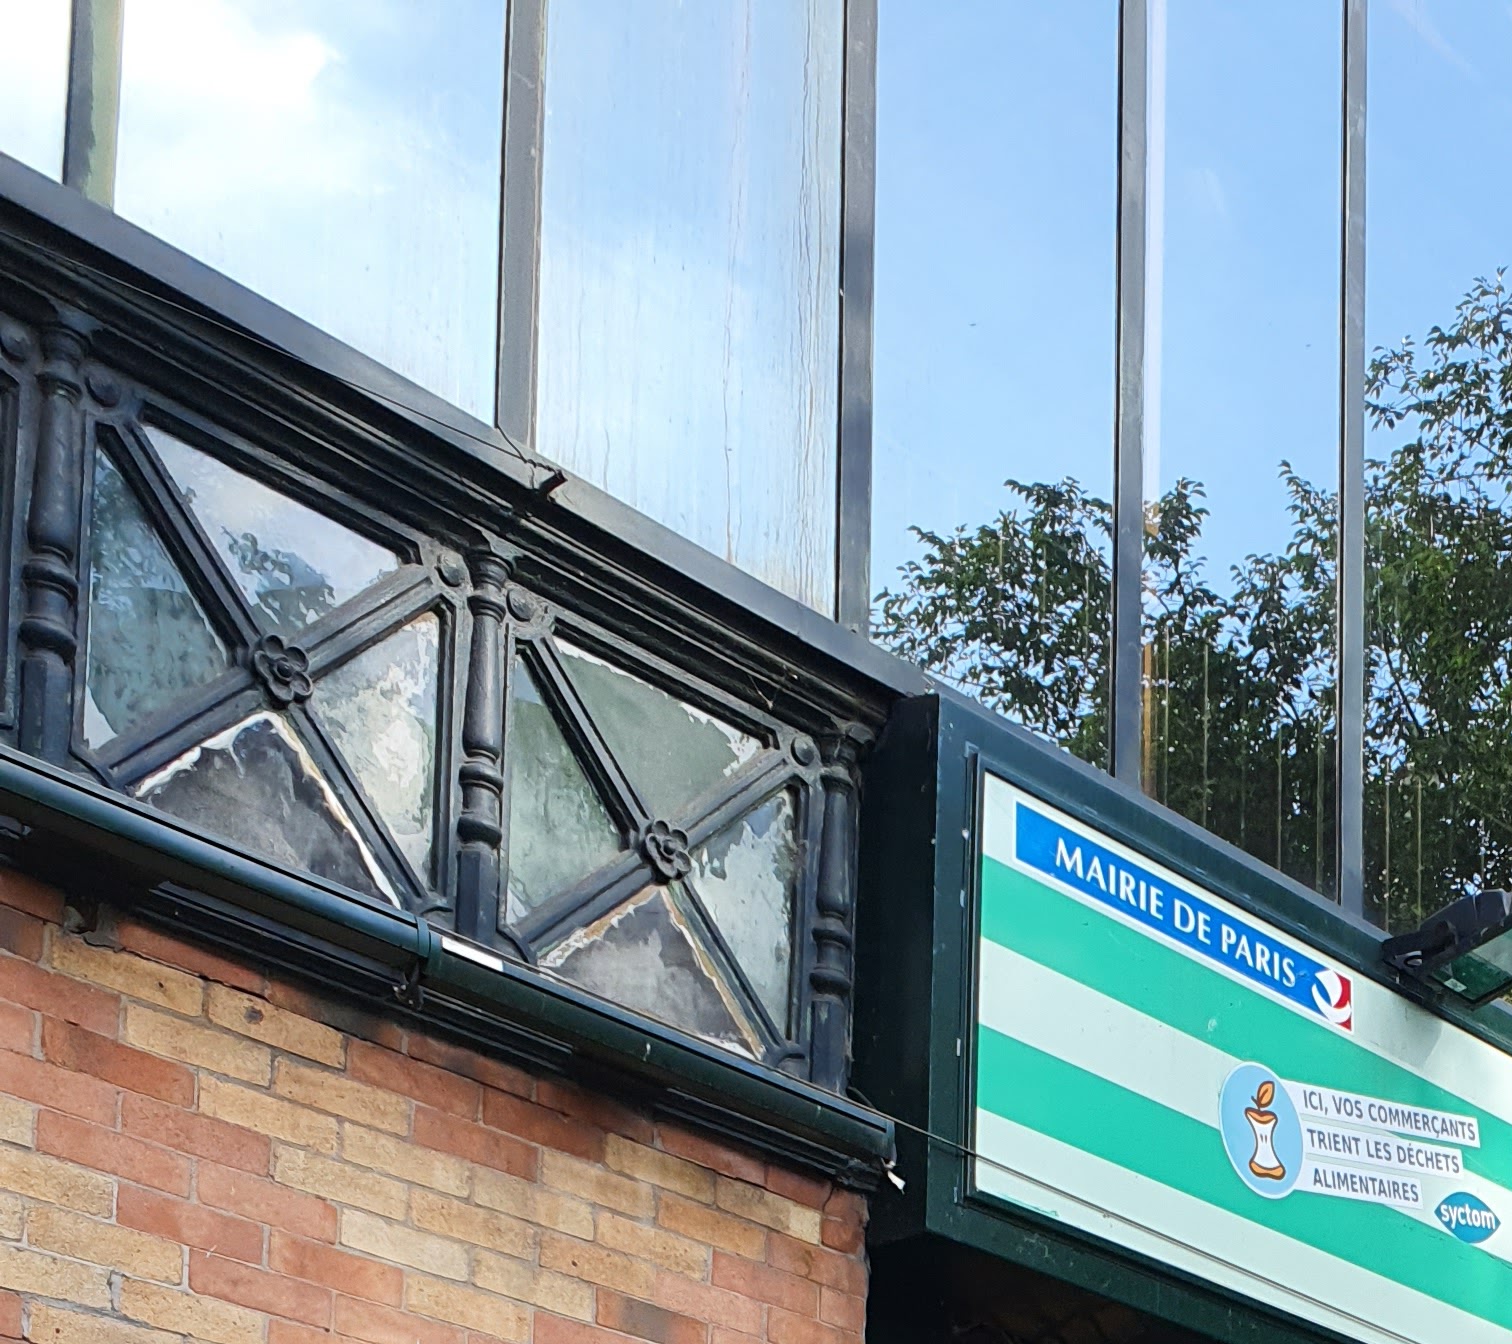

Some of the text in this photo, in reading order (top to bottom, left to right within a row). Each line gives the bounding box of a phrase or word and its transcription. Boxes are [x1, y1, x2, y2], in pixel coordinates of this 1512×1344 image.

[1055, 837, 1296, 988] MAIRIE DE PARIS
[1303, 1089, 1476, 1141] ICI, VOS COMMERÇANTS
[1306, 1128, 1460, 1174] TRIENT LES DÉCHETS
[1313, 1167, 1419, 1203] ALIMENTAIRES
[1440, 1203, 1496, 1230] syctom
